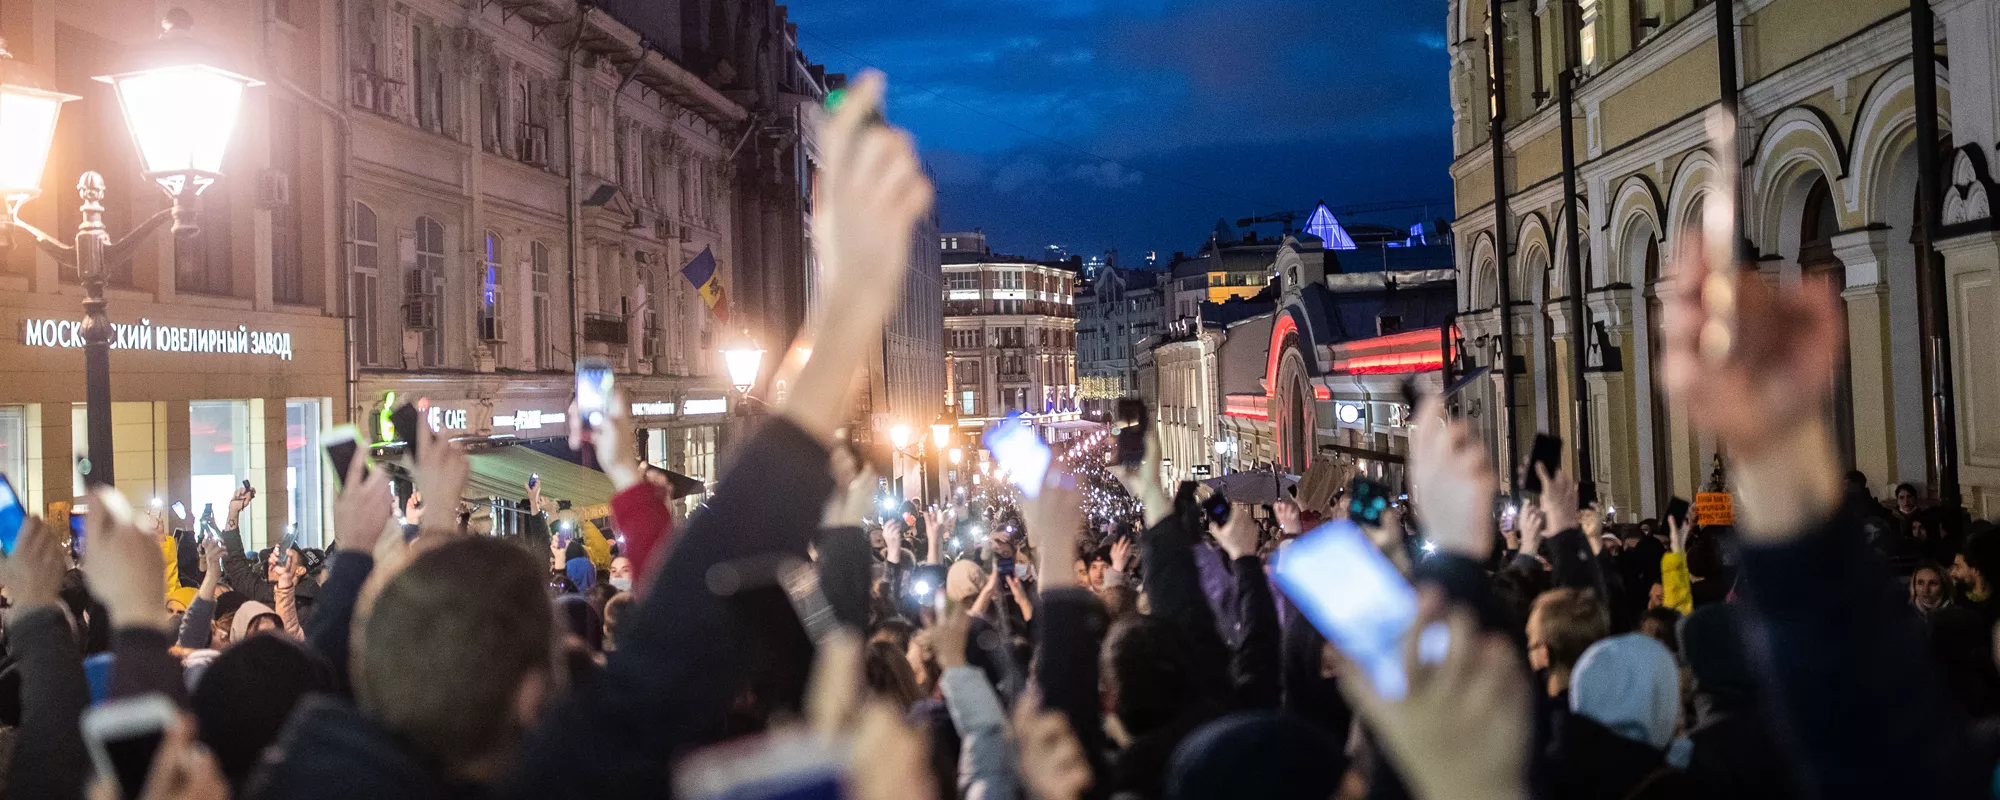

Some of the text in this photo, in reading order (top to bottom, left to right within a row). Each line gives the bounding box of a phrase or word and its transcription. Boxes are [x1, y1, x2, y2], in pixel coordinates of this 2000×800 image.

[26, 318, 292, 360] МОСКСКИЙ ЮВЕЛИРНЫЙ ЗАВОД
[445, 409, 467, 429] CAFE
